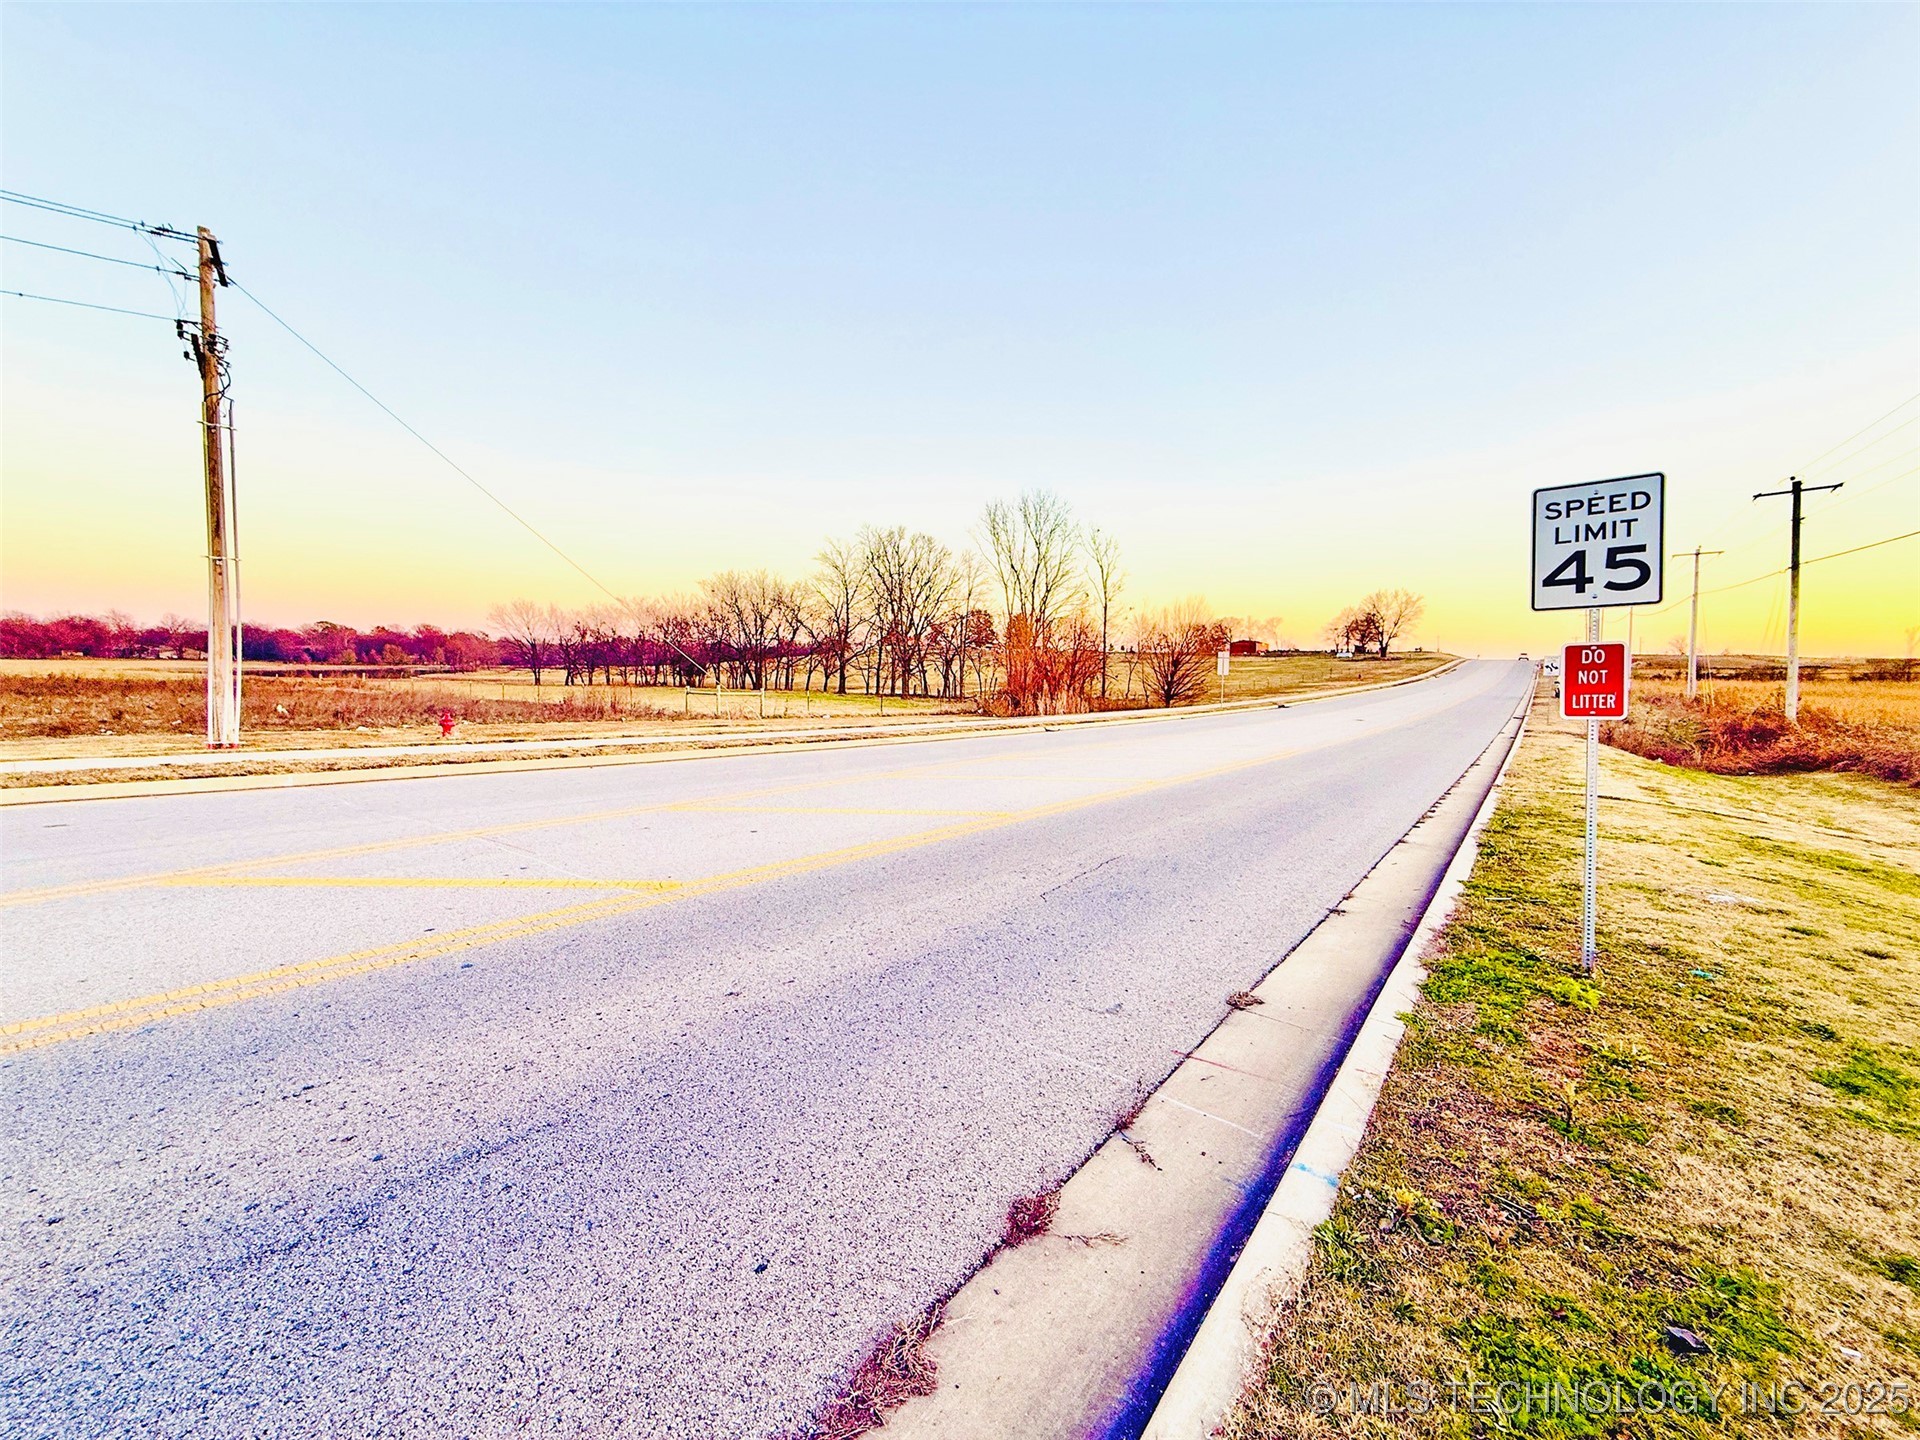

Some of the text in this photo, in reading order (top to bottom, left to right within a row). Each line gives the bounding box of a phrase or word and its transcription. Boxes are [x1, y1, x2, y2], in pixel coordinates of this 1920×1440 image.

[1545, 491, 1651, 520] SPEED
[1555, 518, 1639, 544] LIMIT
[1542, 543, 1651, 594] 45
[1581, 649, 1606, 664] DO
[1578, 670, 1608, 685] NOT
[1572, 694, 1616, 709] LITTER
